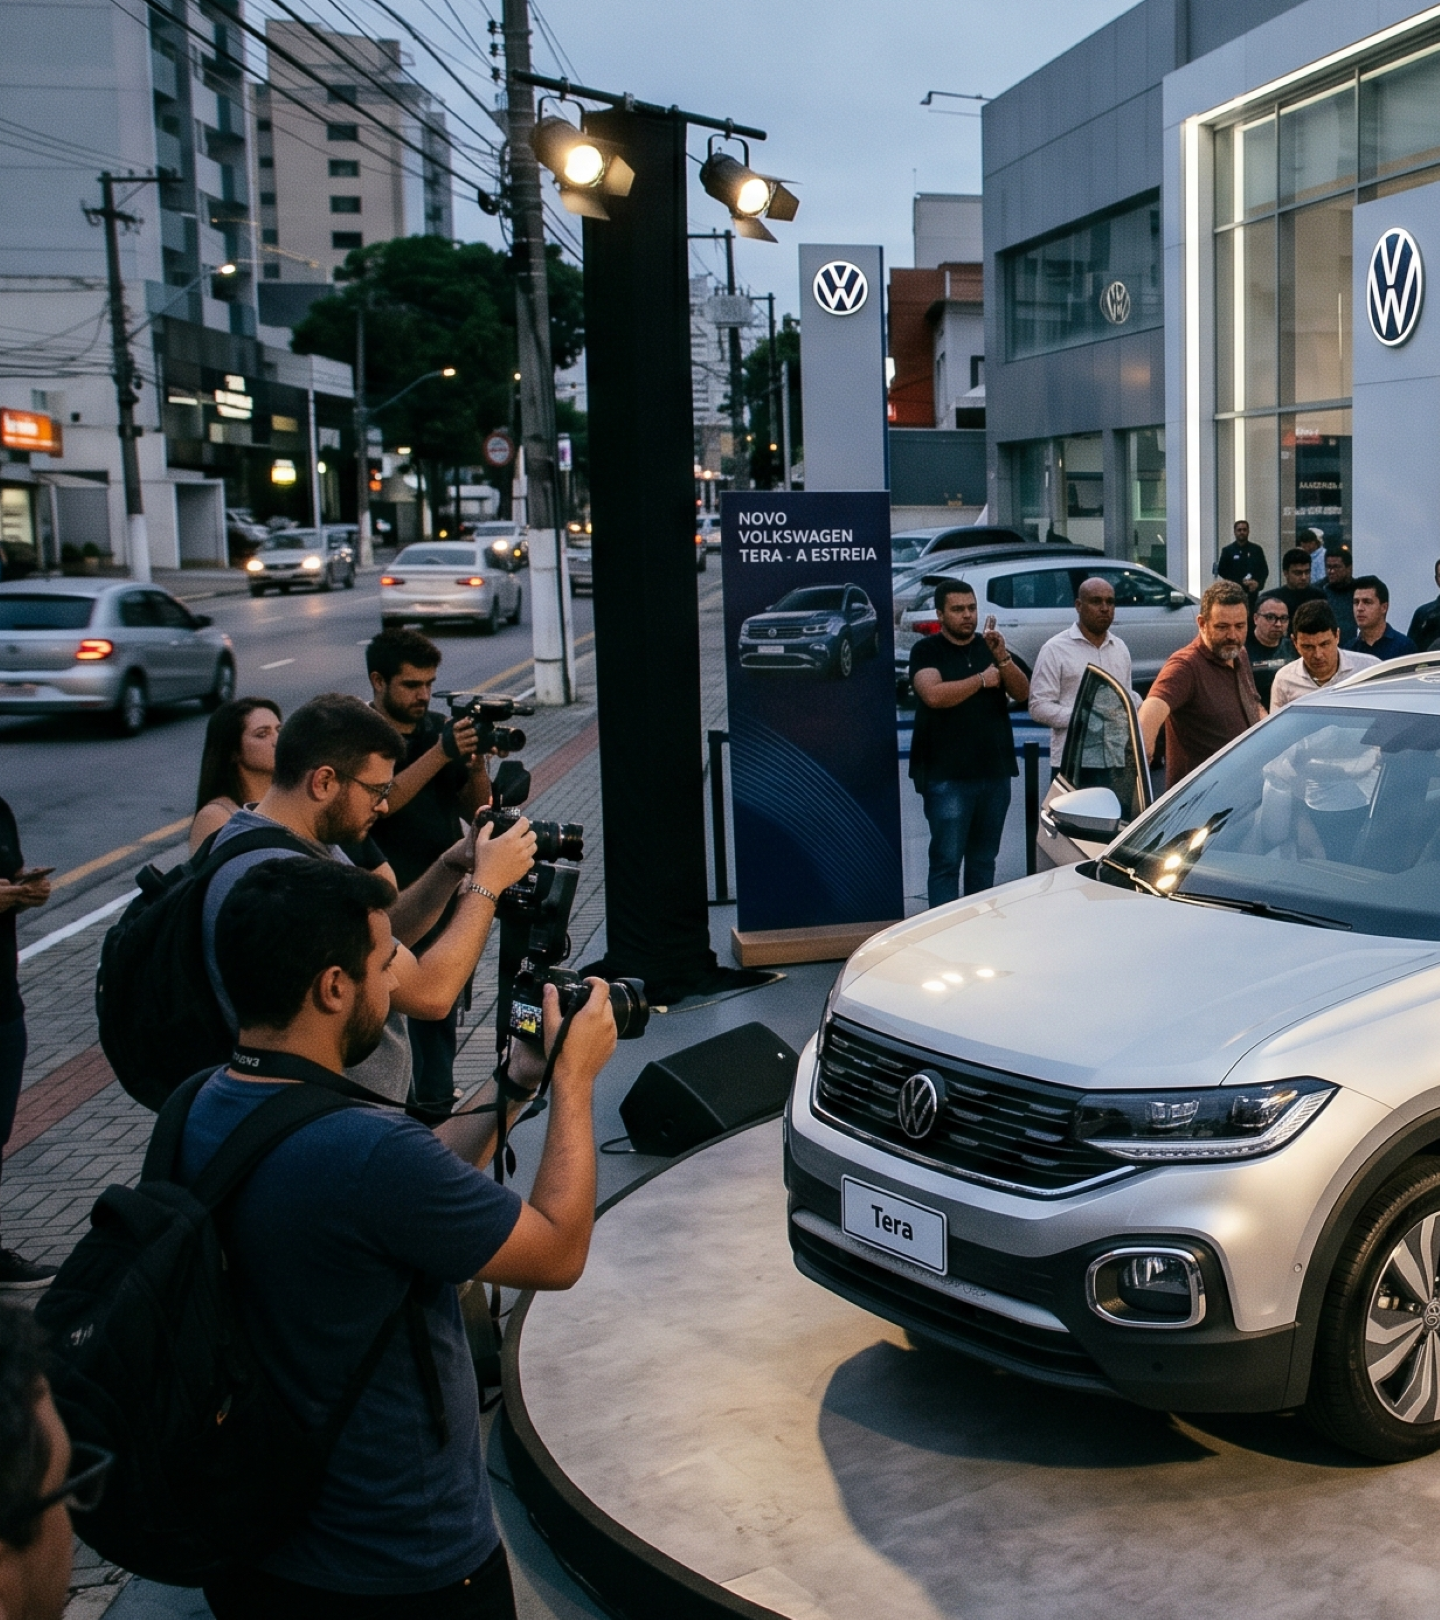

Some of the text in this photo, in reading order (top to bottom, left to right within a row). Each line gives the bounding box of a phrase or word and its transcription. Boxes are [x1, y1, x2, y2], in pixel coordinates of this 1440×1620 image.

[738, 511, 787, 526] NOVO
[738, 529, 853, 544] VOLKSWAGEN
[739, 549, 783, 563] TERA
[796, 548, 808, 562] A
[811, 547, 877, 562] ESTREIA
[871, 1204, 914, 1241] Tera
